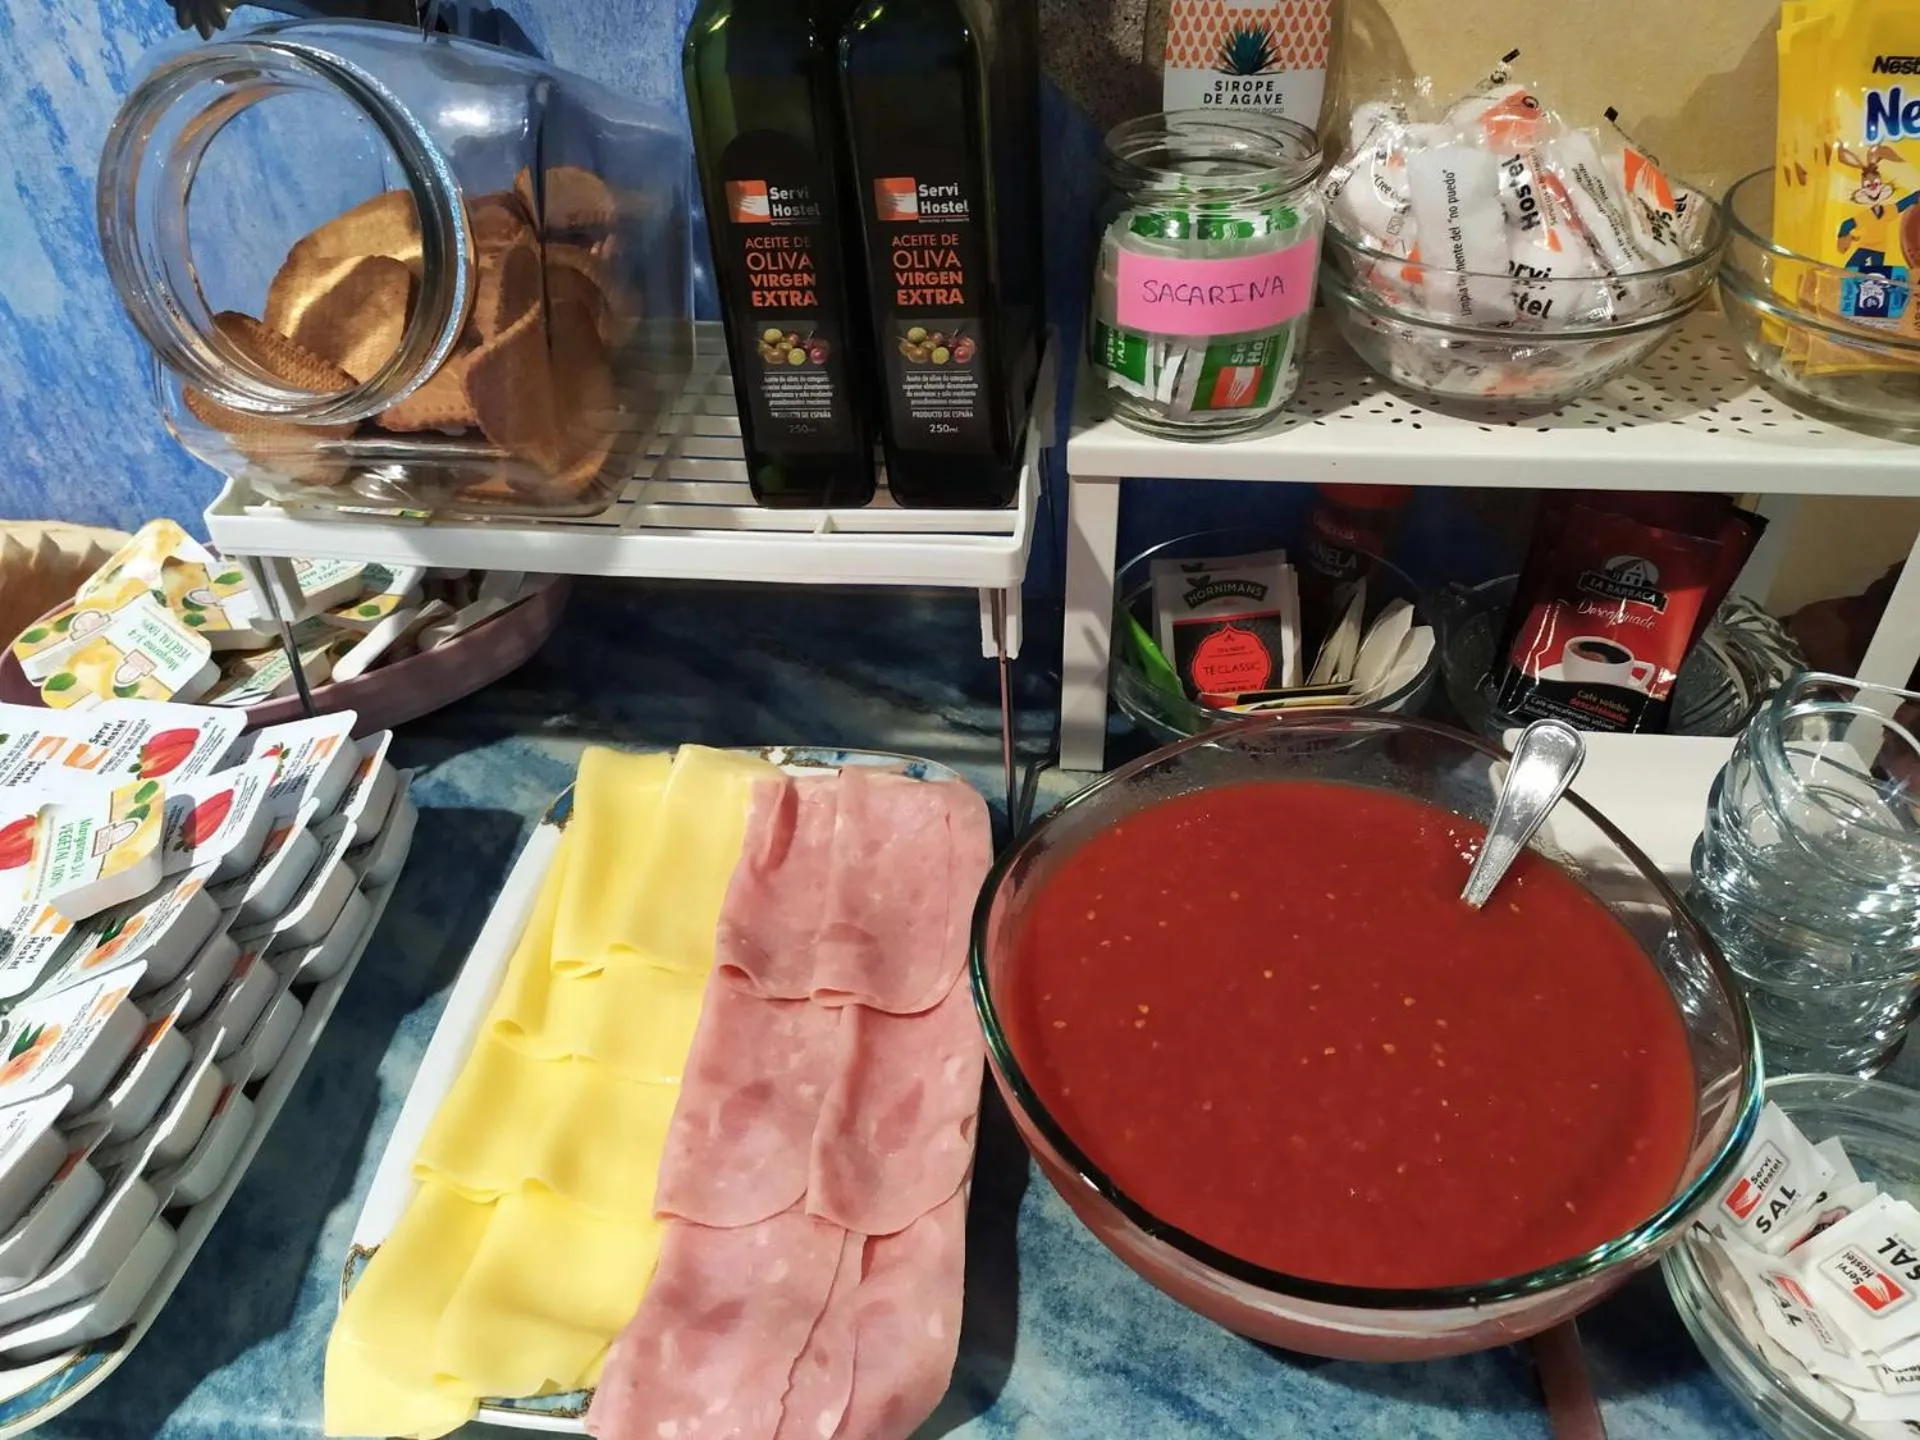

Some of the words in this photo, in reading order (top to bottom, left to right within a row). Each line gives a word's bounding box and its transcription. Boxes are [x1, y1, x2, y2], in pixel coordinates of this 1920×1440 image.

[1214, 80, 1274, 92] SIROPE
[1203, 93, 1223, 104] DE
[1230, 93, 1284, 105] AGAVE
[919, 182, 959, 197] Servi
[921, 199, 970, 214] Hostel
[745, 236, 790, 250] ACEITE
[892, 234, 937, 248] ACEITE
[941, 233, 959, 246] DE
[1448, 226, 1461, 242] del
[747, 251, 814, 271] OLIVA
[893, 250, 962, 269] OLIVA
[750, 273, 816, 287] VIRGEN
[895, 271, 963, 286] VIRGEN
[752, 290, 818, 307] EXTRA
[897, 288, 965, 305] EXTRA
[1141, 275, 1285, 306] SACARINA
[1187, 584, 1263, 605] HORNIMANS
[89, 722, 112, 744] Servi
[100, 719, 128, 746] Hostel
[7, 936, 41, 970] Hostel
[26, 936, 53, 963] Servi
[1750, 1156, 1772, 1184] Servi
[1757, 1158, 1782, 1192] Hostel
[1755, 1185, 1797, 1234] SAL
[1835, 1262, 1864, 1286] Servi
[1841, 1252, 1875, 1279] Hostel
